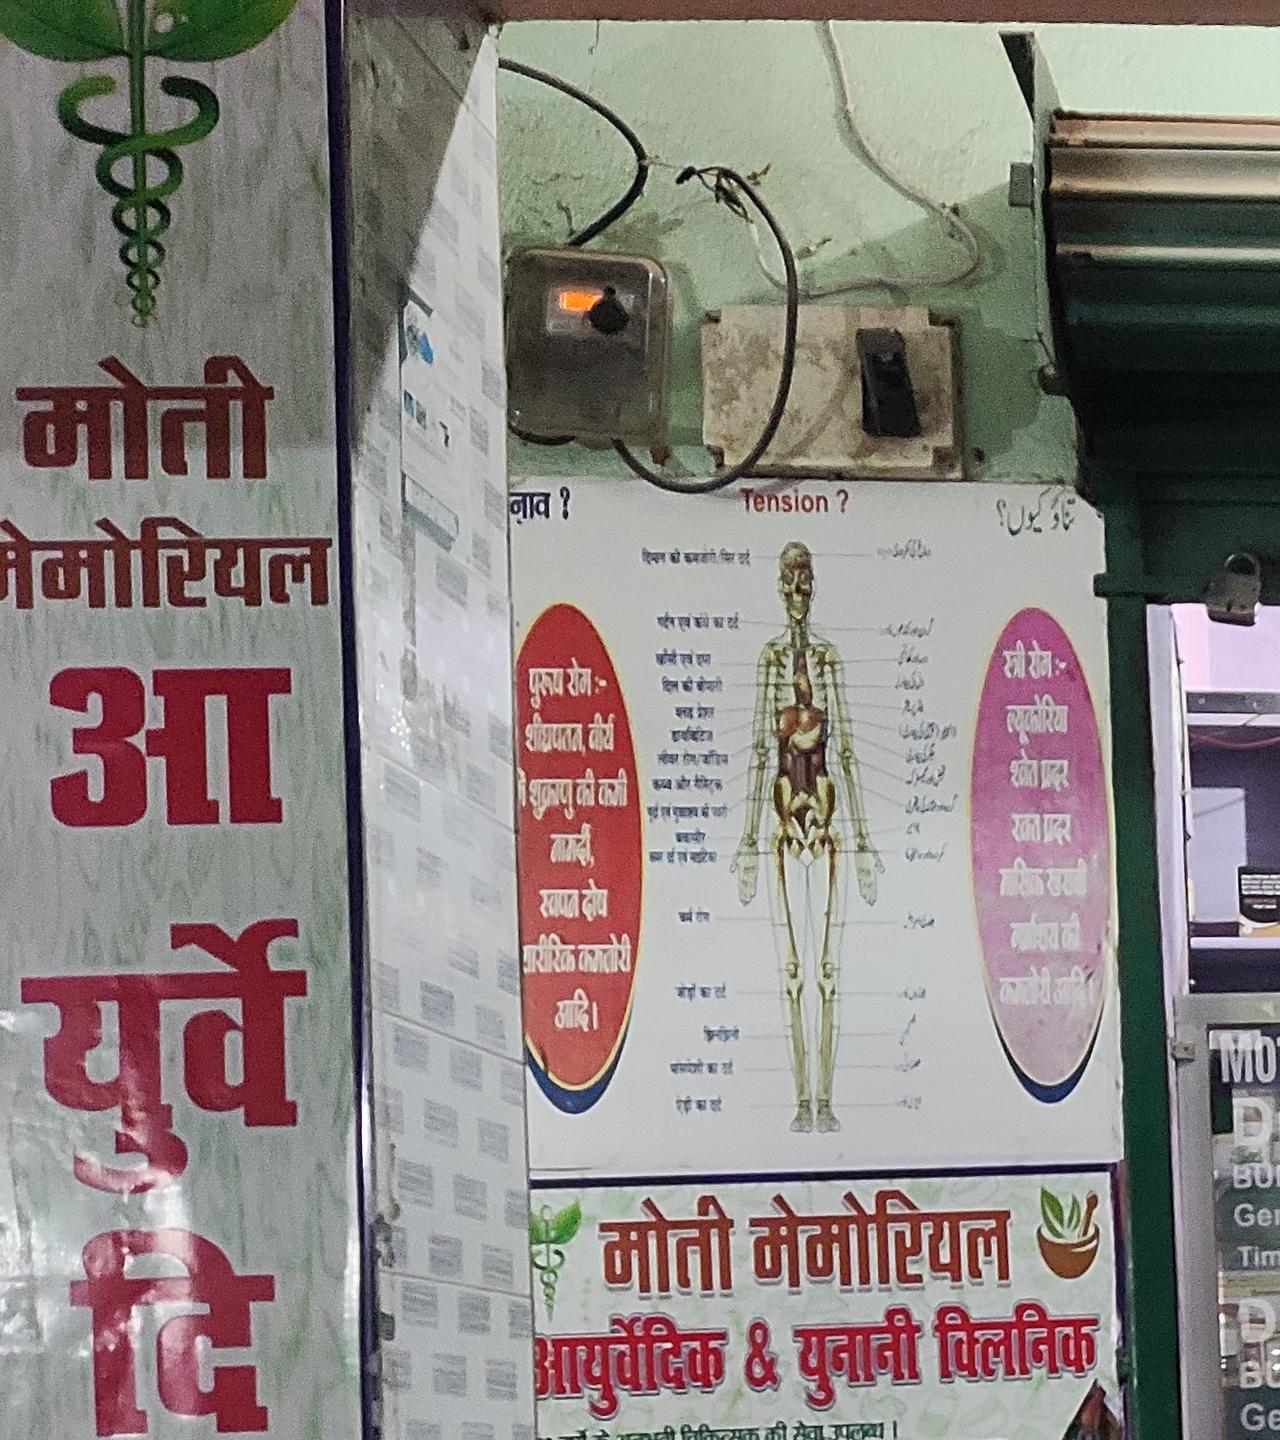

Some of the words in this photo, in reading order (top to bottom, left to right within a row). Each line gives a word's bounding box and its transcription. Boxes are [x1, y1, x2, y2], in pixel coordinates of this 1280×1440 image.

[15, 355, 274, 480] मोती
[740, 488, 829, 513] Tension
[598, 1193, 734, 1296] मोती
[748, 1189, 1011, 1290] मेमोरियल
[744, 1318, 780, 1391] &
[793, 1304, 923, 1410] युनानी
[934, 1300, 1101, 1381] क्लिनिक
